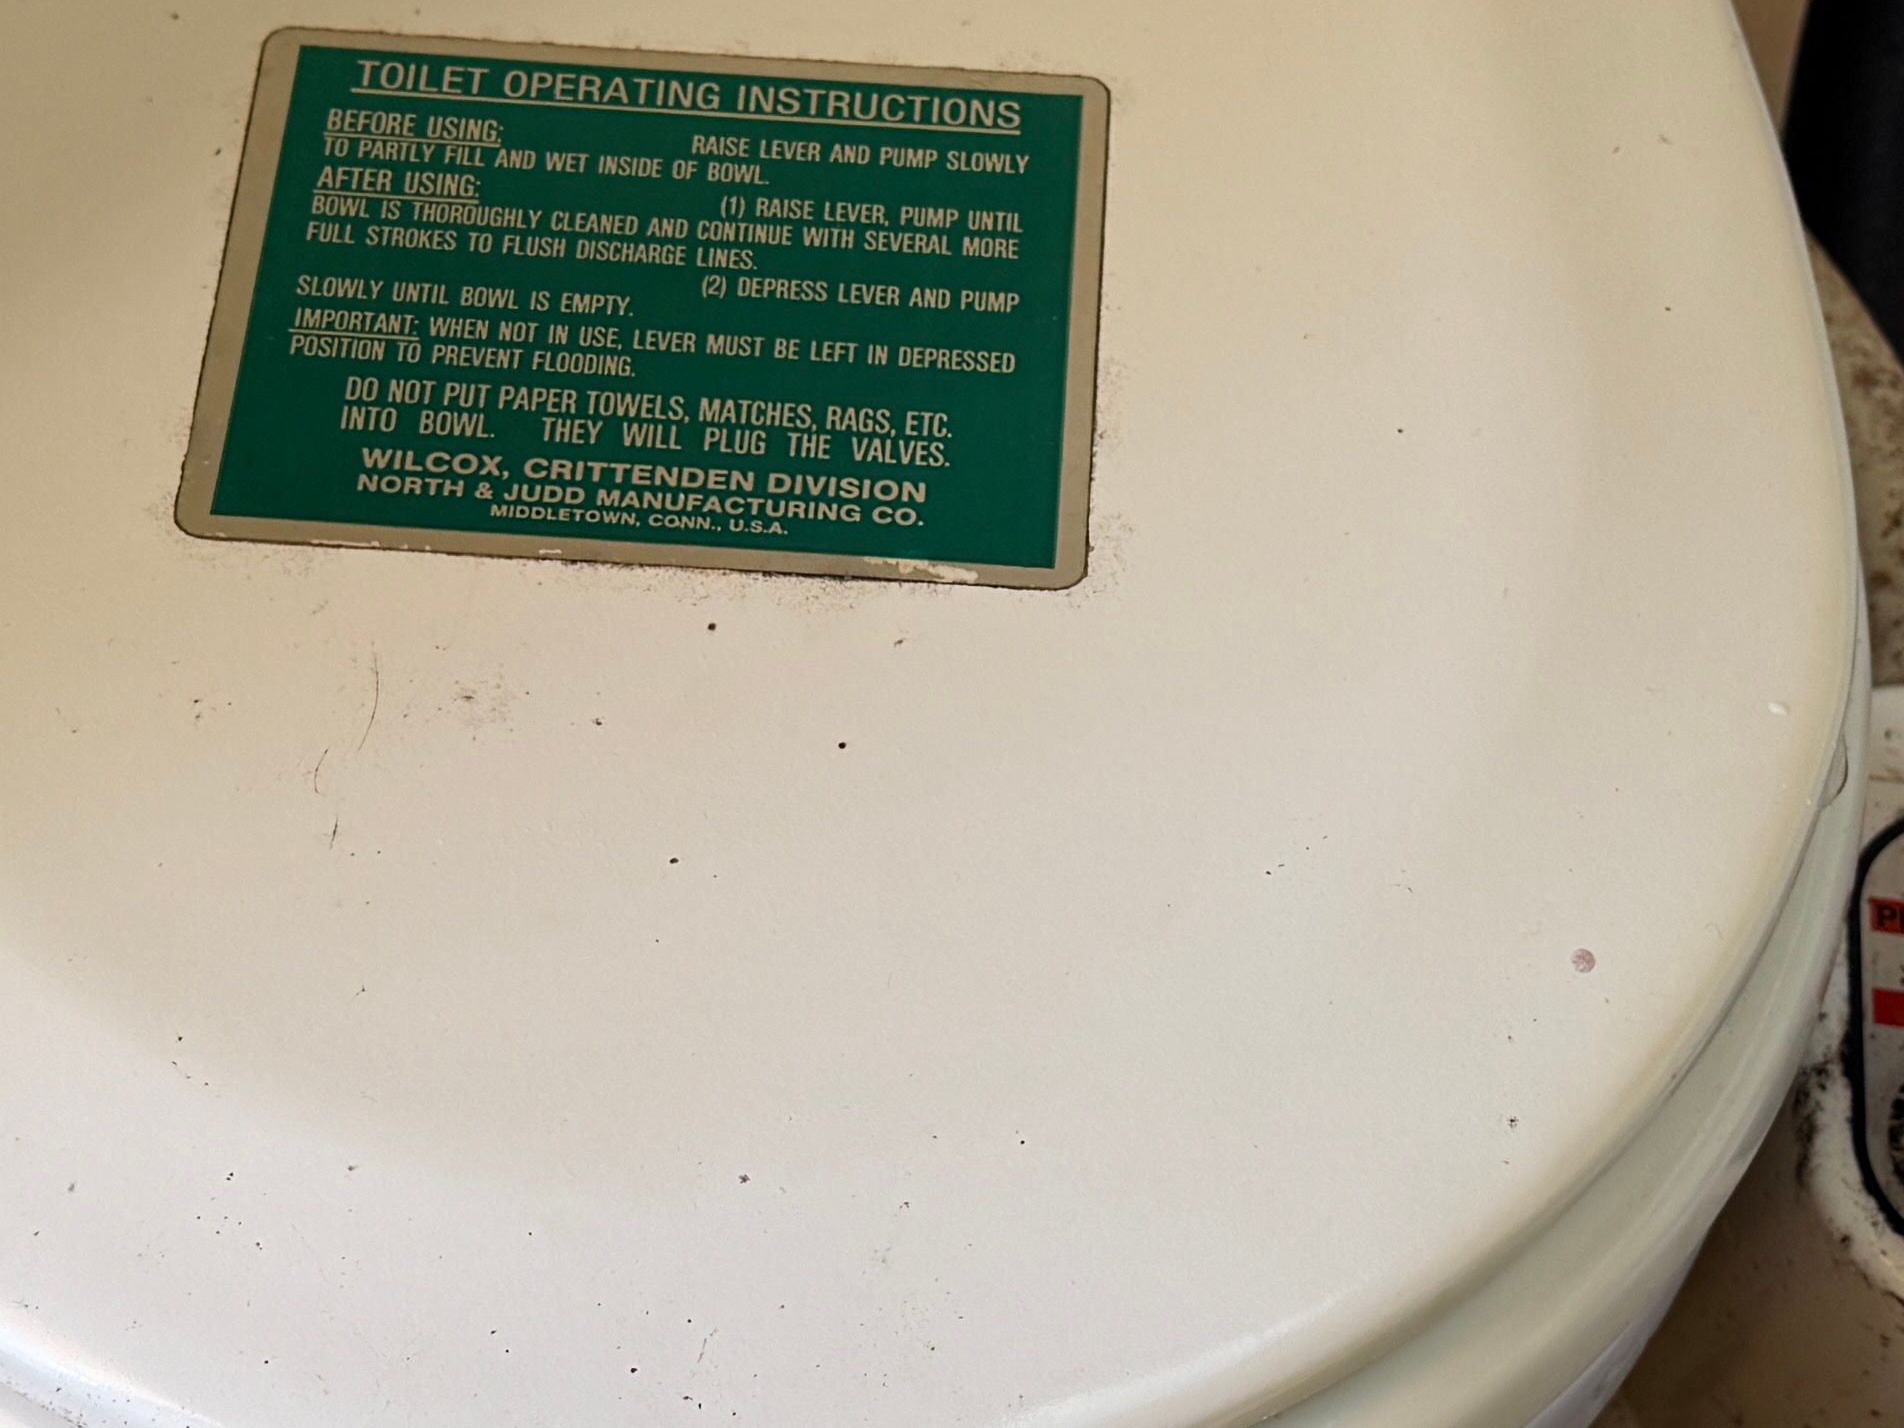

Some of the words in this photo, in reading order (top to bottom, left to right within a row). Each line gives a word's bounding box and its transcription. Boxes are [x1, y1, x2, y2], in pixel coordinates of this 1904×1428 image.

[358, 60, 490, 95] TOILET
[503, 70, 720, 110] OPERATING
[737, 84, 1021, 129] INSTRUCTIONS
[324, 136, 350, 157] TO
[357, 138, 436, 163] PARTLY
[444, 144, 485, 167] FILL
[494, 148, 537, 170] AND
[545, 151, 589, 173] WET
[598, 155, 663, 179] INSIDE
[672, 159, 698, 180] OF
[707, 161, 769, 185] BOWL.
[326, 108, 417, 137] BEFORE
[427, 115, 504, 144] USING:
[691, 134, 750, 158] RAISE
[759, 139, 821, 162] LEVER
[829, 143, 871, 165] AND
[879, 146, 938, 169] PUMP
[946, 150, 1030, 174] SLOWLY
[311, 194, 369, 218] BOWL
[380, 199, 401, 220] IS
[412, 201, 542, 229] THOROUGHLY
[550, 210, 639, 236] CLEANED
[646, 217, 689, 239] AND
[696, 220, 793, 246] CONTINUE
[802, 226, 855, 249] WITH
[864, 230, 952, 256] SEVERAL
[962, 236, 1019, 260] MORE
[316, 165, 393, 192] AFTER
[404, 171, 481, 198] USING:
[720, 195, 746, 219] (1)
[755, 197, 815, 220] RAISE
[823, 201, 889, 227] LEVER,
[900, 205, 959, 229] PUMP
[967, 210, 1023, 233] UNTIL
[306, 221, 355, 244] FULL
[365, 225, 457, 251] STROKES
[468, 231, 493, 253] TO
[502, 234, 567, 258] FLUSH
[575, 239, 687, 266] DISCHARGE
[696, 247, 757, 270] LINES.
[296, 274, 384, 300] SLOWLY
[392, 281, 449, 305] UNTIL
[460, 286, 519, 310] BOWL
[530, 290, 551, 311] IS
[560, 292, 633, 317] EMPTY.
[701, 274, 727, 299] (2)
[737, 276, 828, 302] DEPRESS
[837, 283, 900, 306] LEVER
[908, 287, 951, 310] AND
[960, 289, 1020, 313] PUMP
[290, 334, 386, 361] POSITION
[397, 341, 422, 364] TO
[431, 344, 524, 370] PREVENT
[531, 350, 635, 377] FLOODING.
[294, 307, 419, 335] IMPORTANT:
[429, 316, 489, 340] WHEN
[498, 321, 539, 343] NOT
[547, 324, 569, 345] IN
[578, 325, 622, 350] USE,
[632, 329, 697, 353] LEVER
[706, 334, 765, 357] MUST
[773, 337, 800, 360] BE
[810, 340, 859, 363] LEFT
[867, 344, 888, 365] IN
[898, 346, 1016, 374] DEPRESSED
[345, 376, 379, 402] DO
[387, 379, 437, 405] NOT
[443, 382, 492, 408] PUT
[498, 385, 577, 414] PAPER
[586, 390, 690, 424] TOWELS,
[698, 397, 817, 432] MATCHES,
[825, 405, 896, 438] RAGS,
[905, 410, 953, 438] ETC.
[340, 405, 398, 432] INTO
[418, 410, 495, 438] BOWL.
[542, 417, 603, 445] THEY
[623, 421, 682, 450] WILL
[703, 427, 767, 455] PLUG
[787, 432, 832, 460] THE
[851, 436, 950, 467] VALVES.
[357, 474, 465, 497] NORTH
[474, 481, 493, 500] &
[503, 483, 586, 505] JUDD
[596, 488, 861, 523] MANUFACTURING
[871, 506, 924, 526] CO.
[362, 447, 509, 480] WILCOX,
[523, 457, 755, 492] CRITTENDEN
[767, 472, 927, 504] DIVISION
[490, 504, 641, 528] MIDDLETOWN,
[648, 513, 722, 532] CONN.,
[729, 518, 788, 535] U.S.A.
